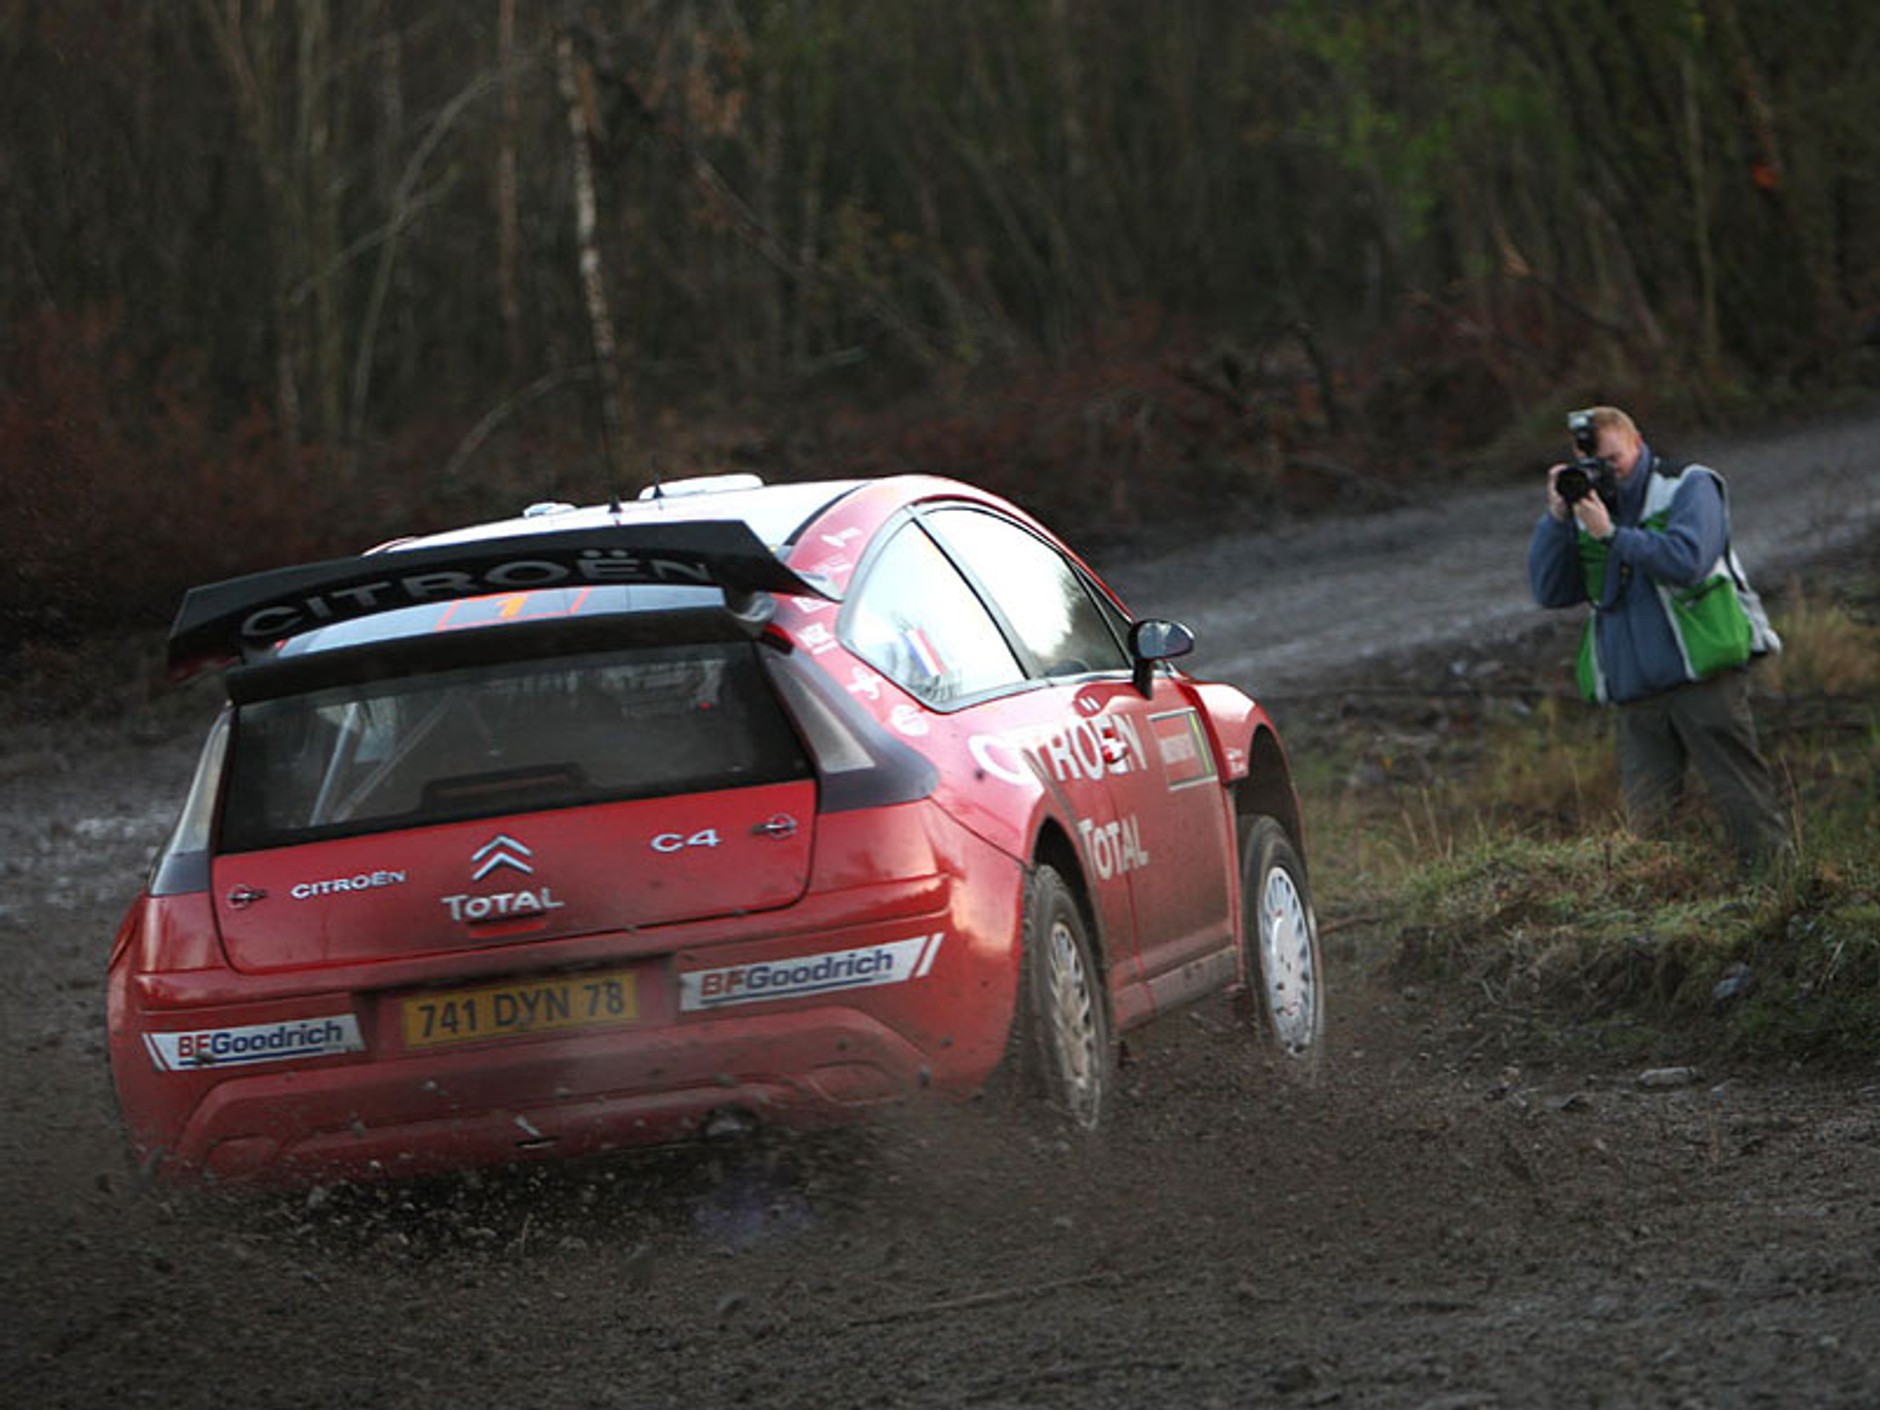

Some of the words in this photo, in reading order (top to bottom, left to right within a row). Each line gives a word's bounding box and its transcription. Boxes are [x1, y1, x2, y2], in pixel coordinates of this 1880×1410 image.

[242, 549, 710, 637] CITROËN
[650, 829, 720, 852] C4
[290, 869, 406, 899] CITROËN
[701, 949, 894, 998] BFGoodrich
[418, 1004, 478, 1038] 741
[493, 988, 571, 1028] DYN
[582, 981, 625, 1017] 78
[178, 1020, 344, 1057] BFGoodrich
